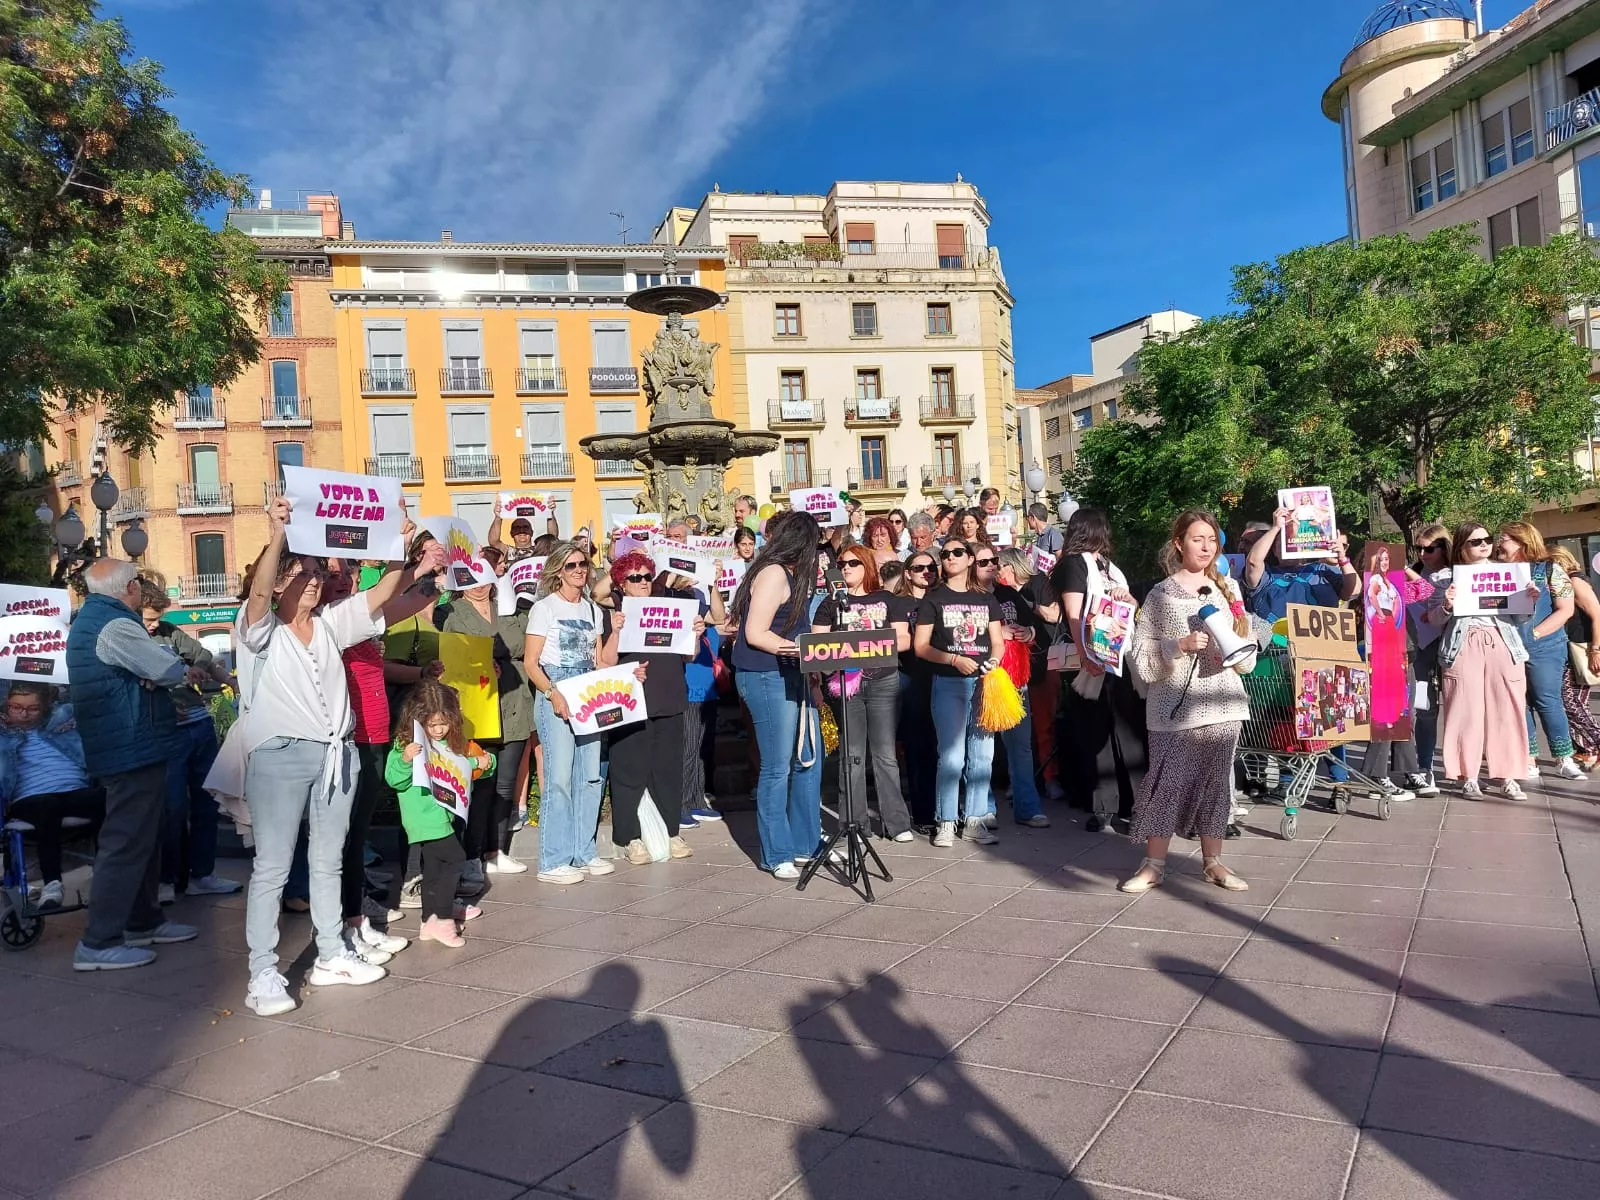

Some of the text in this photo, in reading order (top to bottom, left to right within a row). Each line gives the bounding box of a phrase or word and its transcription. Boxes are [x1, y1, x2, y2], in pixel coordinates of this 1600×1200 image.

[320, 483, 379, 503] VOTA A
[315, 501, 385, 521] LORENA
[805, 501, 837, 511] LORENA
[652, 539, 695, 551] LORENA
[695, 540, 727, 548] LORENA
[1473, 571, 1512, 582] VOTA A
[1471, 583, 1517, 593] LORENA
[6, 598, 50, 613] LORENA
[642, 607, 680, 617] VOTA A
[640, 618, 683, 629] LORENA
[1292, 608, 1356, 642] LORE
[9, 629, 63, 644] LORENA
[578, 679, 634, 703] LORENA
[575, 691, 638, 723] GANADORA
